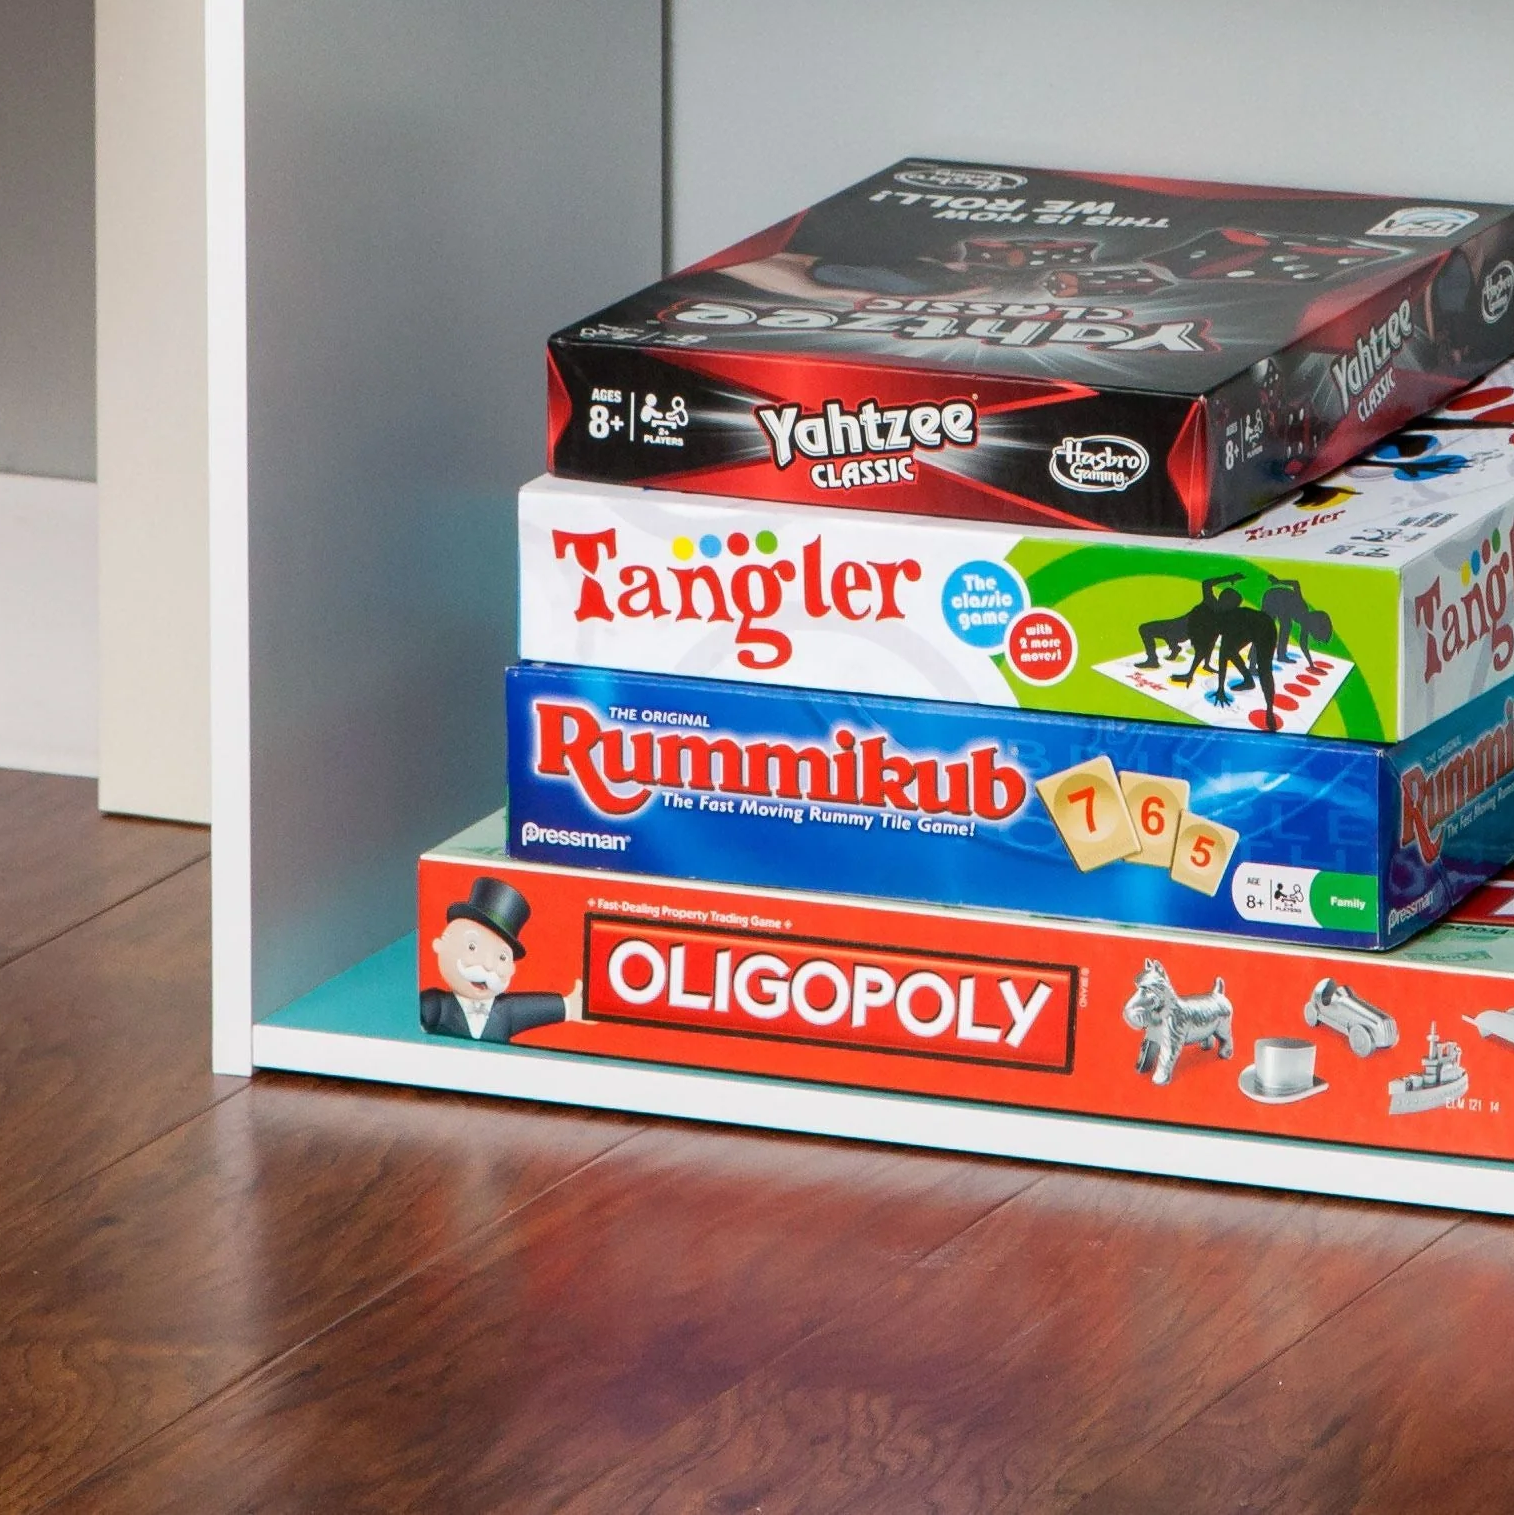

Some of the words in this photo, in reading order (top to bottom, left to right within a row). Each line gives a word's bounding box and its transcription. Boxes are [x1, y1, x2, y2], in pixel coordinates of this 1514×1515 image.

[868, 189, 1027, 213] ROLL!
[1032, 199, 1117, 216] WE
[933, 209, 1029, 224] HOW
[1033, 213, 1077, 226] IS
[1082, 214, 1171, 229] THIS
[864, 298, 1125, 321] CLASSIC
[674, 301, 1206, 354] Yahtzee
[1331, 299, 1413, 416] Yahtzee
[591, 387, 623, 403] AGES
[1357, 367, 1397, 423] CLASSIC
[588, 405, 625, 439] 8+
[757, 398, 978, 468] Yahtzee
[643, 433, 684, 447] PLAYERS
[1054, 439, 1141, 471] Hasbro
[810, 455, 916, 490] CLASSIC
[1069, 461, 1127, 487] Gaming
[1244, 509, 1347, 543] Tangler
[961, 573, 998, 592] The
[551, 527, 923, 670] Tangler
[951, 590, 1014, 610] classic
[958, 610, 1011, 631] game
[1025, 623, 1053, 637] with
[1019, 638, 1028, 649] 2
[1030, 638, 1062, 649] more
[1020, 649, 1063, 663] moves!
[608, 706, 638, 722] THE
[641, 709, 711, 729] ORIGINAL
[535, 702, 1028, 821] Rummikub
[662, 791, 694, 811] The
[699, 795, 735, 814] Fast
[739, 800, 804, 824] Moving
[809, 805, 875, 831] Rummy
[879, 811, 913, 832] Tile
[917, 816, 977, 837] Game!
[1067, 786, 1098, 835] 7
[1140, 796, 1166, 837] 6
[1190, 835, 1218, 868] 5
[597, 897, 661, 918] Fast-Dealing
[661, 904, 709, 922] Property
[710, 910, 750, 928] Trading
[750, 914, 783, 929] Game
[1246, 894, 1265, 910] 8+
[1329, 895, 1367, 910] Family
[607, 936, 1054, 1049] OLIGOPOLY
[1489, 1101, 1501, 1113] 14
